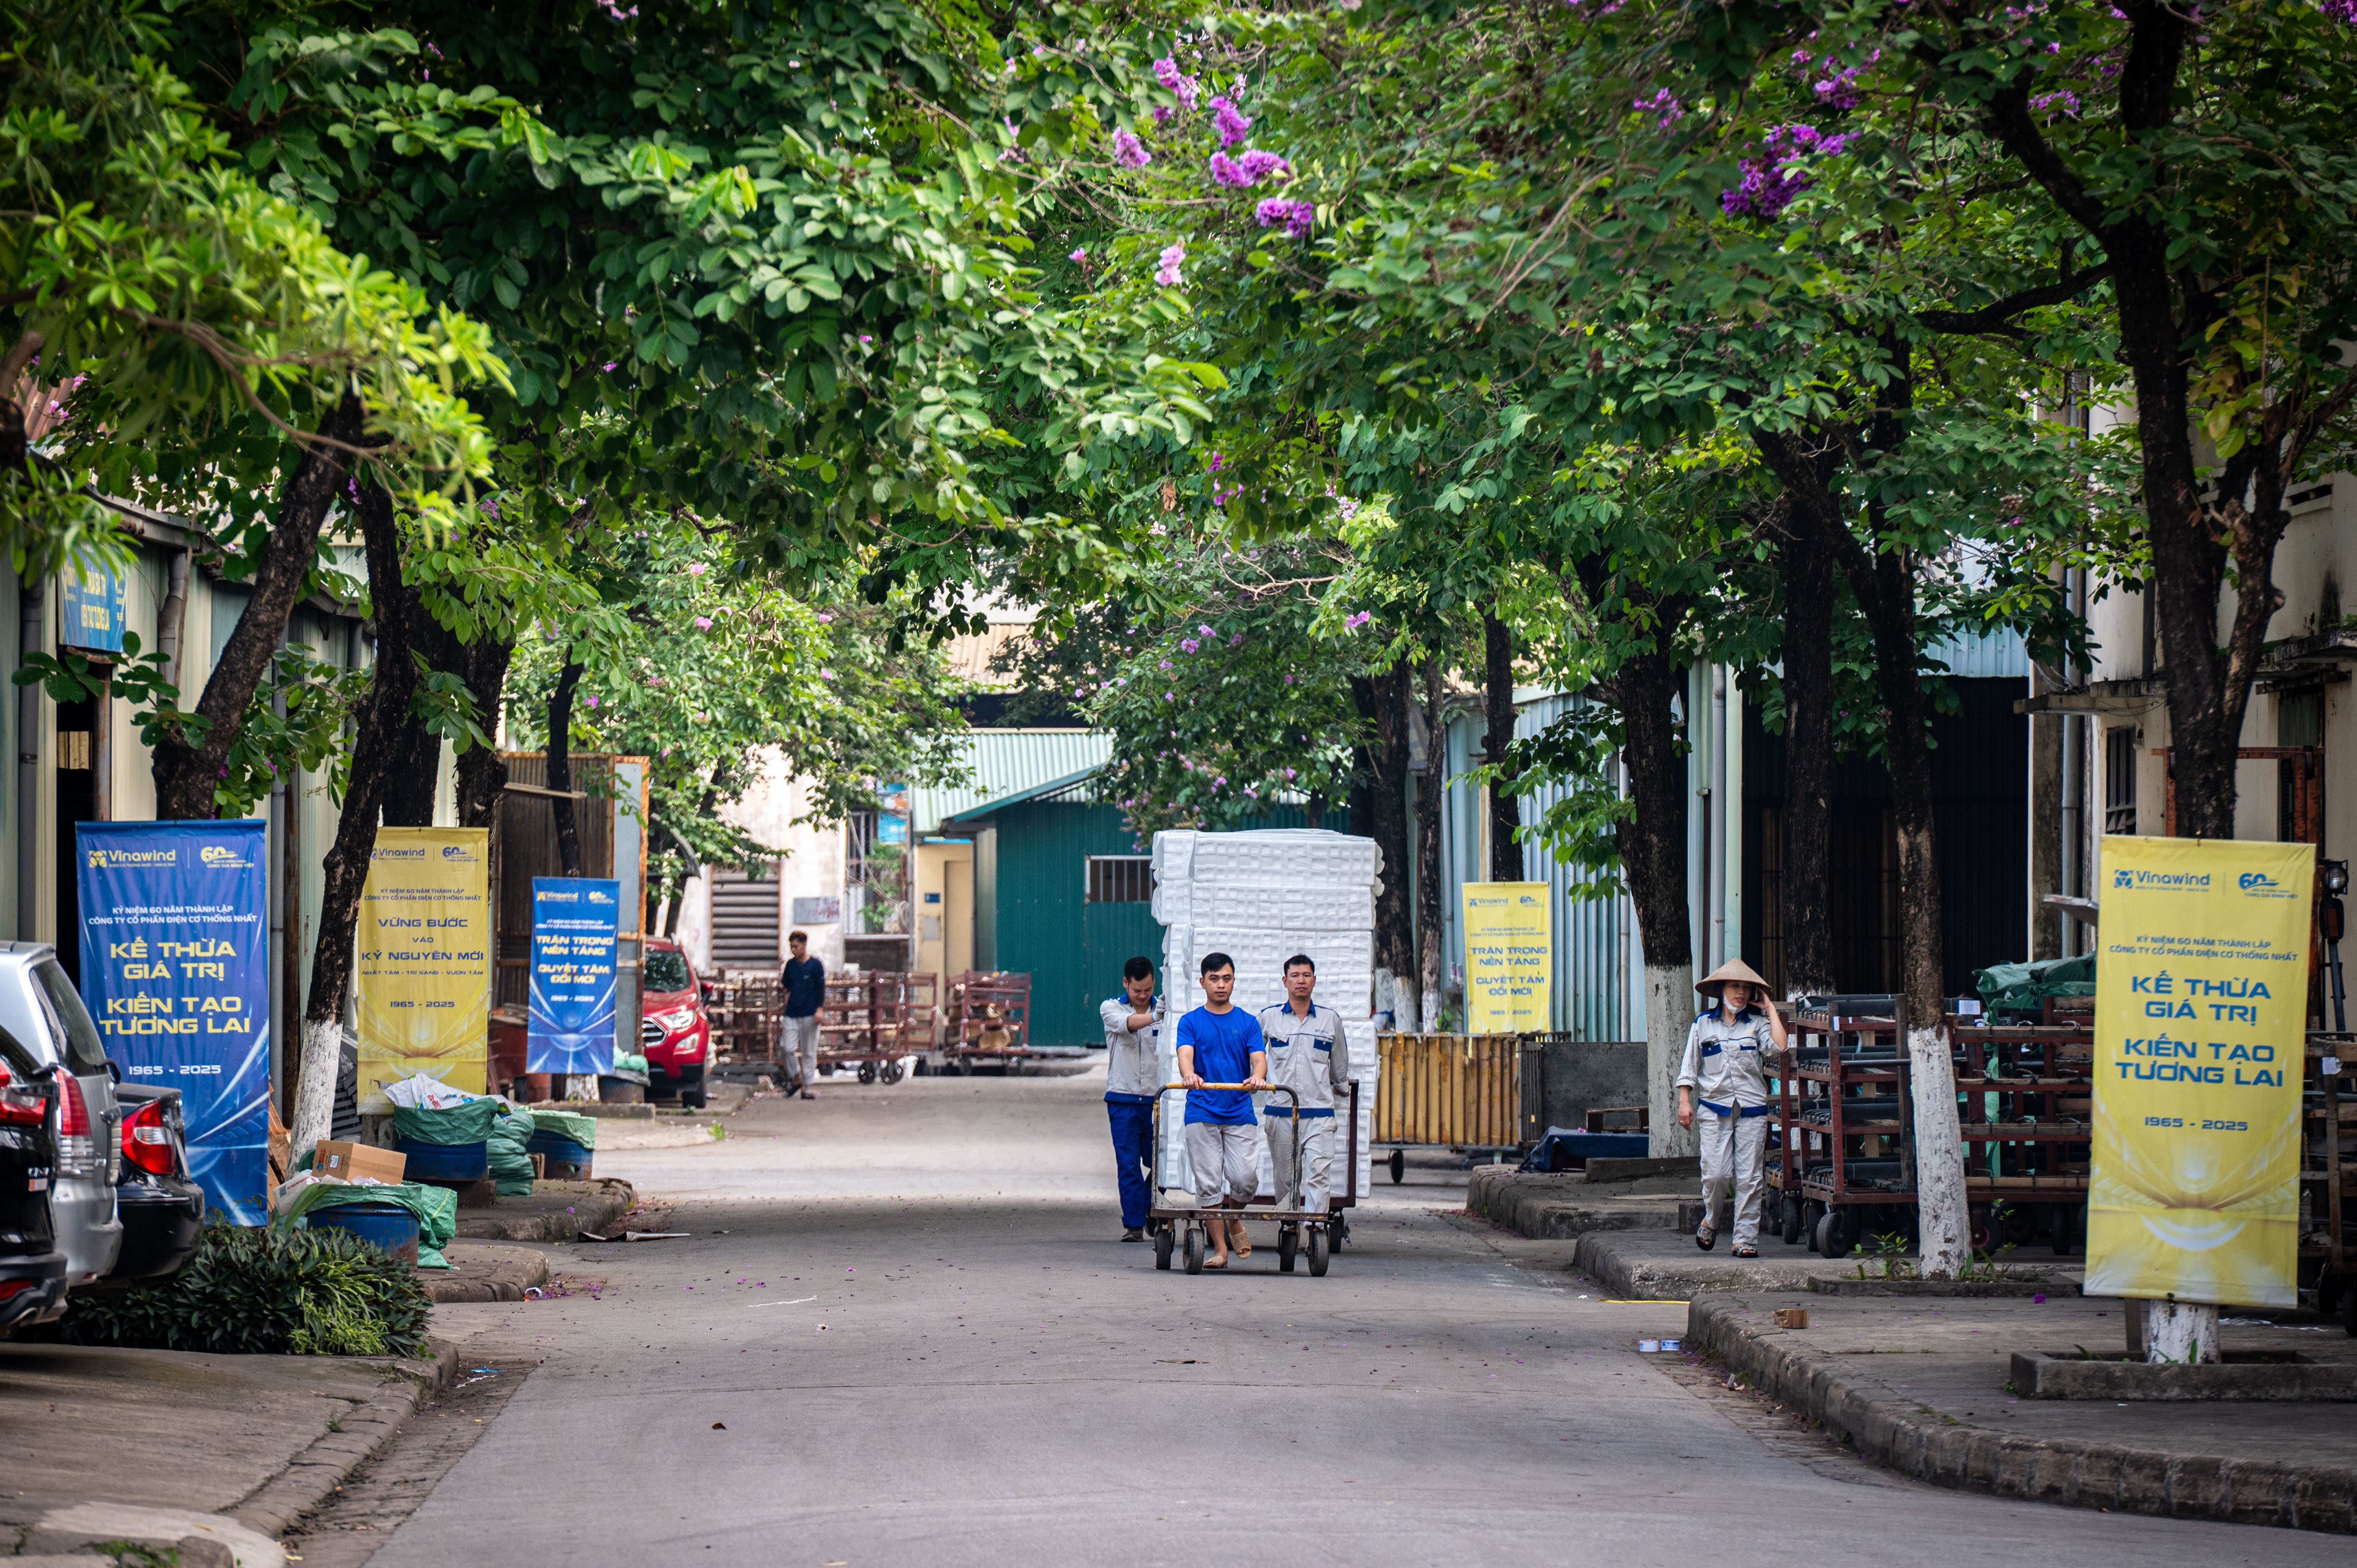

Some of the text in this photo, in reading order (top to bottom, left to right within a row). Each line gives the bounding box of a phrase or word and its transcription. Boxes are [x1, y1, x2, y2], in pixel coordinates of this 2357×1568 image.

[108, 849, 176, 862] Vinawind
[200, 846, 227, 862] 60
[379, 848, 425, 856] Vinawind
[442, 847, 460, 858] 60
[2136, 871, 2210, 886] Vinawind
[2238, 873, 2267, 890] 60
[112, 905, 124, 914] KỶ
[125, 905, 147, 916] NIỆM
[163, 905, 184, 913] NĂM
[185, 904, 215, 913] THÀNH
[216, 904, 233, 914] LẬP
[88, 916, 113, 924] CÔNG
[127, 914, 139, 924] CỔ
[140, 915, 164, 923] PHẦN
[166, 915, 187, 924] ĐIỆN
[202, 914, 232, 922] THỐNG
[234, 913, 257, 922] NHẤT
[378, 917, 468, 927] VỮNG BƯỚC
[110, 936, 237, 958] KẾ THỪA
[535, 934, 614, 946] TRÂN TRỌNG
[2151, 935, 2175, 945] NIỆM
[2193, 937, 2215, 946] NĂM
[2217, 938, 2250, 948] THÀNH
[2252, 940, 2271, 950] LẬP
[362, 950, 483, 960] KỶ NGUYÊN MỚI
[1471, 945, 1547, 956] TRÂN TRỌNG
[2110, 944, 2136, 953] CÔNG
[2220, 950, 2234, 958] CƠ
[2236, 950, 2269, 960] THỐNG
[2271, 951, 2298, 961] NHẤT
[1506, 956, 1540, 965] TẢNG
[124, 960, 224, 981] GIÁ TRỊ
[582, 964, 610, 974] TÂM
[573, 974, 596, 984] MỚI
[1518, 975, 1545, 984] TÂM
[2131, 970, 2271, 999] KẾ THỪA
[107, 991, 241, 1015] KIẾN TẠO
[2145, 998, 2257, 1026] GIÁ TRỊ
[99, 1016, 250, 1035] TƯƠNG LAI
[2124, 1033, 2274, 1065] KIẾN TẠO
[128, 1066, 163, 1075] 1965
[180, 1065, 221, 1074] 2025
[2114, 1060, 2283, 1087] TƯƠNG LAI
[2145, 1116, 2183, 1128] 1965
[2202, 1120, 2248, 1131] 2025
